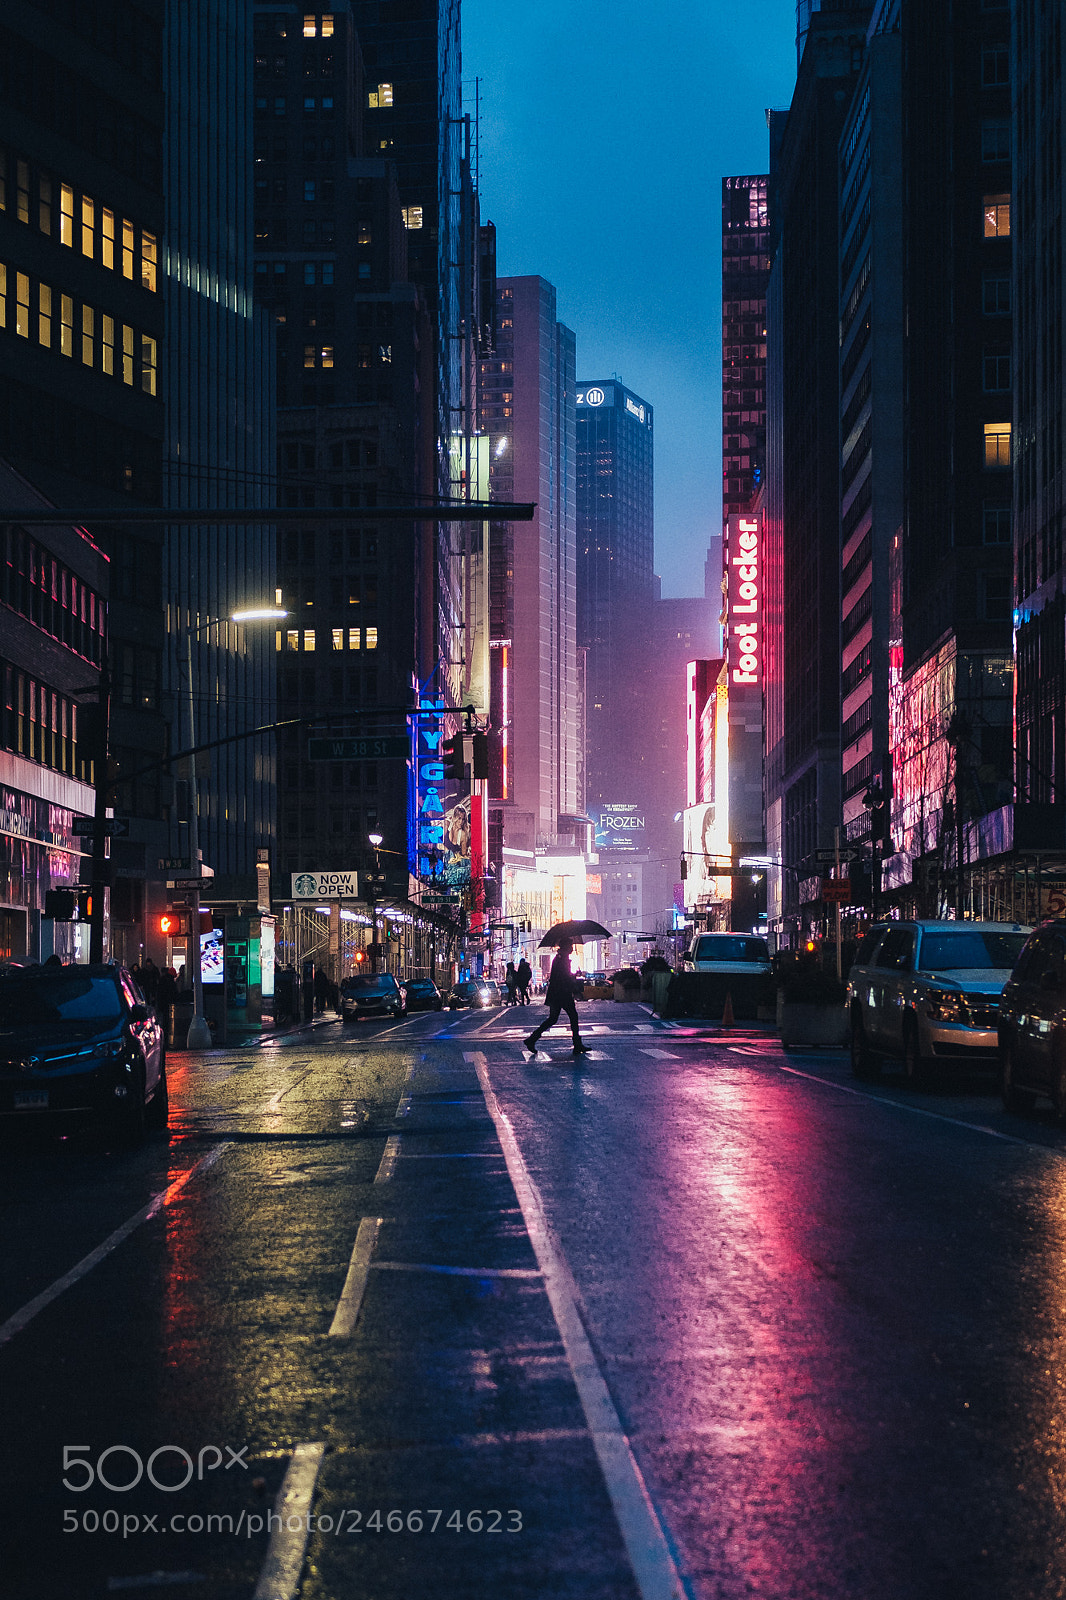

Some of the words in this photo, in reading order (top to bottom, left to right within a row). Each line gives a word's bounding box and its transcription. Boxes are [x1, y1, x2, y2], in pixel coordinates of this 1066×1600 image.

[732, 623, 758, 683] Foot
[332, 742, 344, 756] W
[351, 741, 367, 756] 38
[374, 741, 388, 755] St
[600, 813, 645, 831] FROZEN
[320, 874, 352, 885] NOW
[318, 884, 354, 896] OPEN
